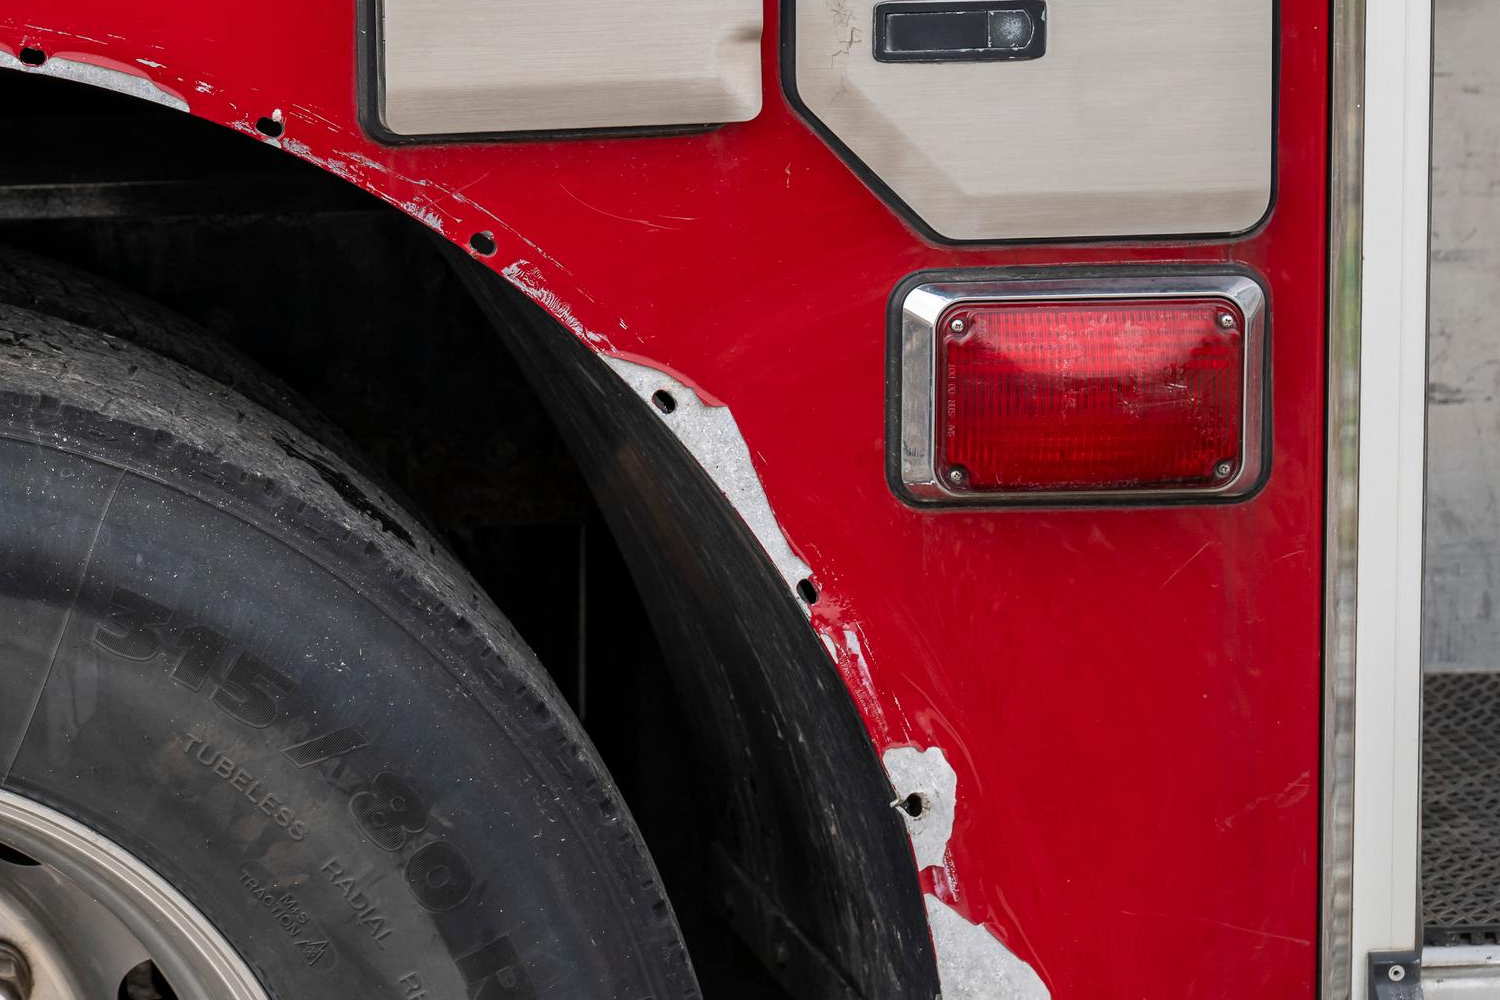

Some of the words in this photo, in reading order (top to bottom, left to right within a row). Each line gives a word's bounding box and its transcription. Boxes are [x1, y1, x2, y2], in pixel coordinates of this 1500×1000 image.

[180, 732, 309, 842] TUBELESS
[320, 857, 393, 952] RADIAL
[237, 867, 302, 938] TRACTION
